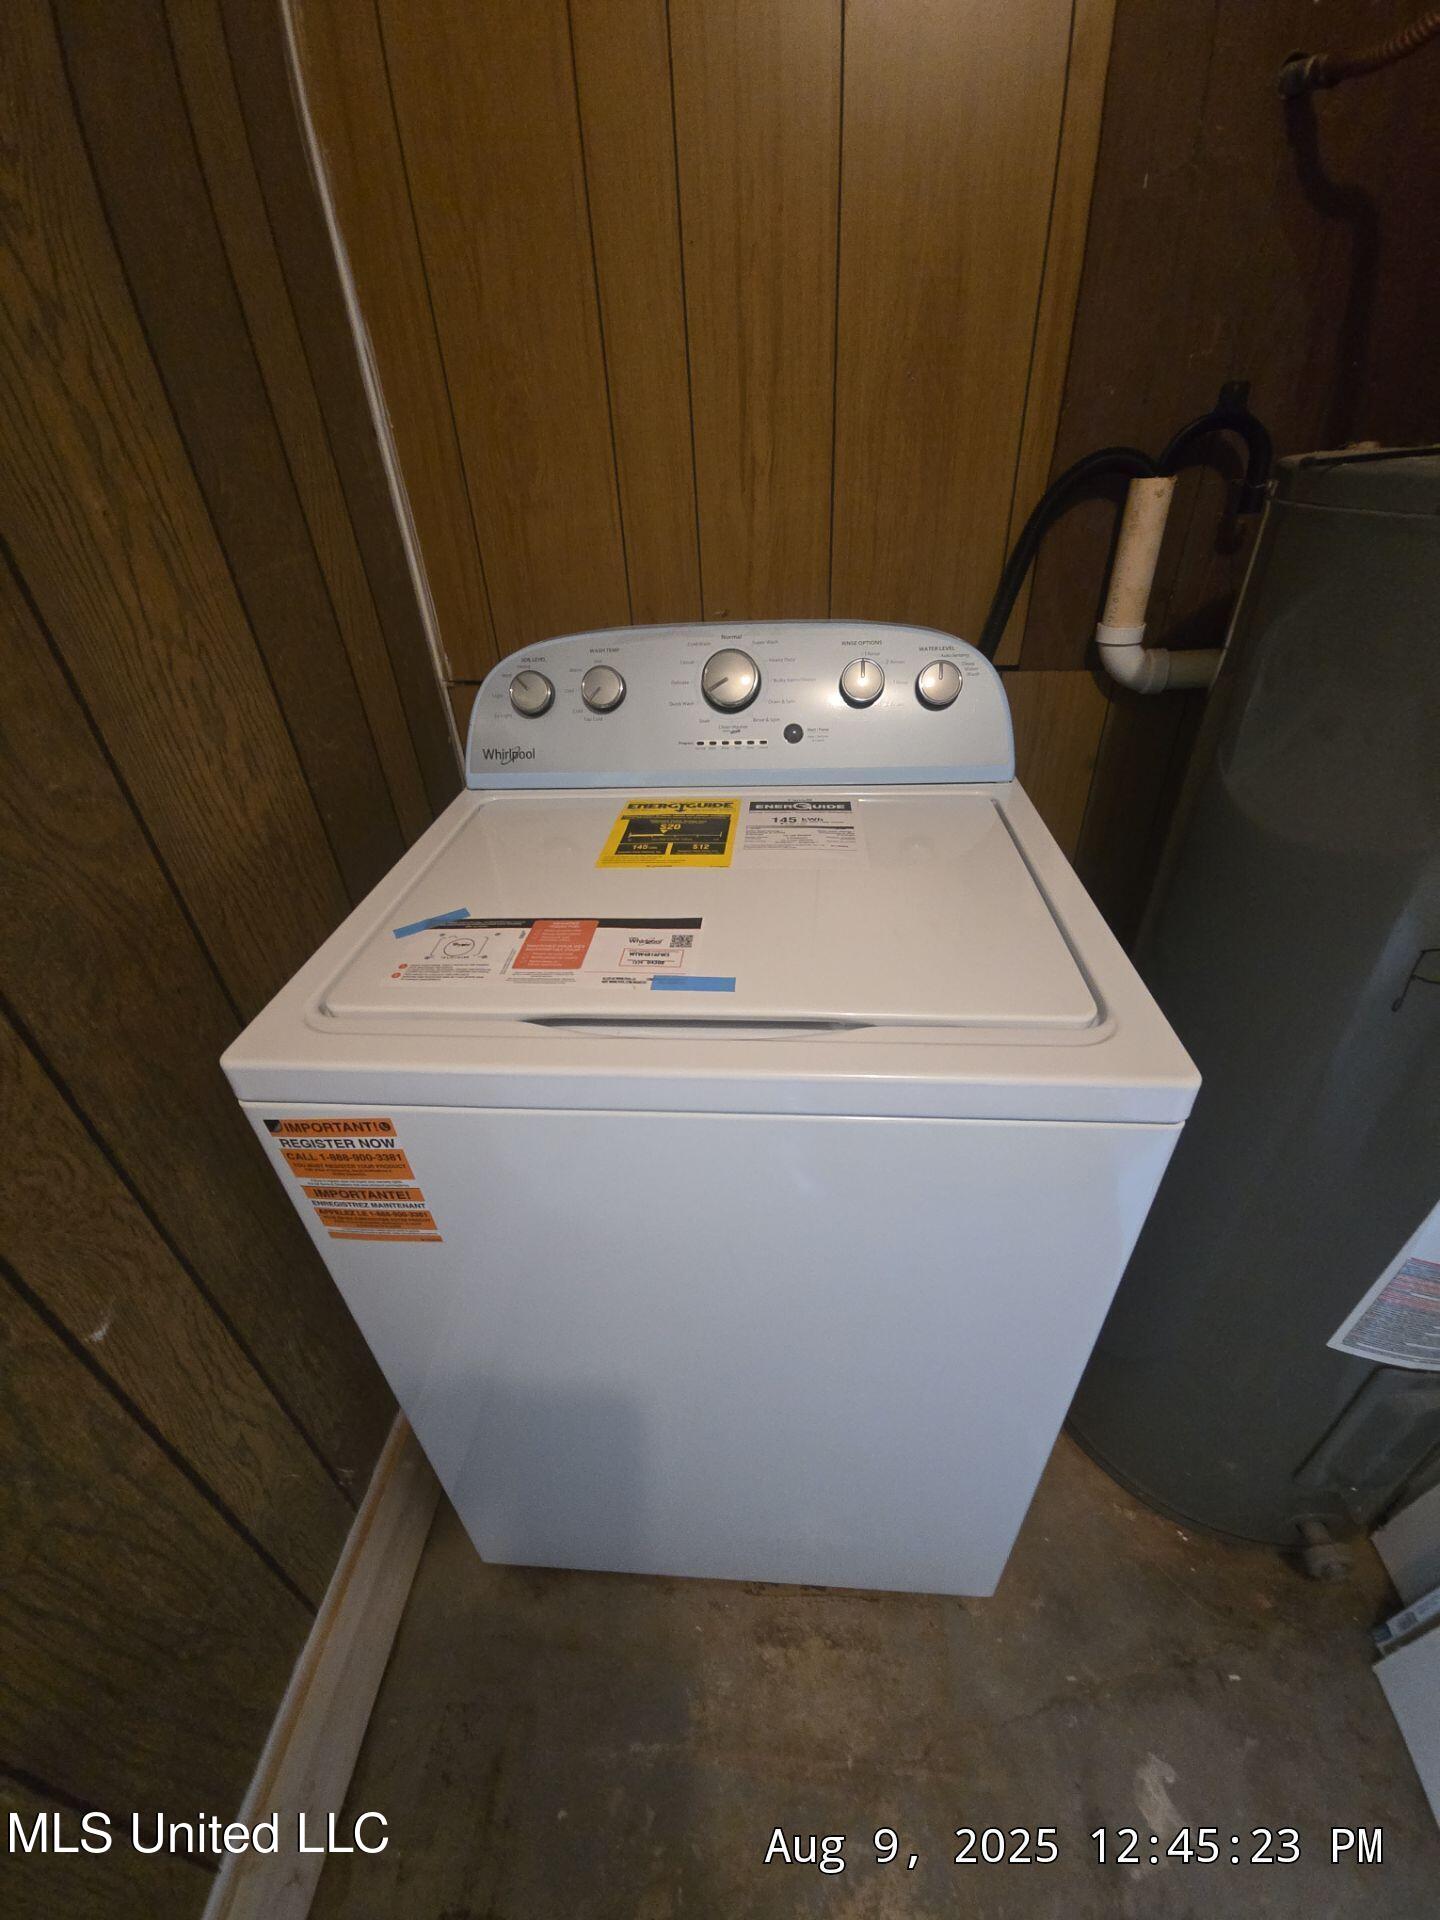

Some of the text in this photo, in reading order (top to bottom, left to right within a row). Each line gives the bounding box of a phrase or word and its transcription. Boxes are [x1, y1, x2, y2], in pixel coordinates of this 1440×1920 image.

[482, 746, 536, 765] Whirlpool
[771, 816, 797, 824] 145
[283, 1121, 379, 1133] IMPORTANT!
[279, 1138, 395, 1149] REGISTER NOW
[286, 1152, 318, 1161] CALL
[311, 1200, 368, 1208] ENREGISTREZ
